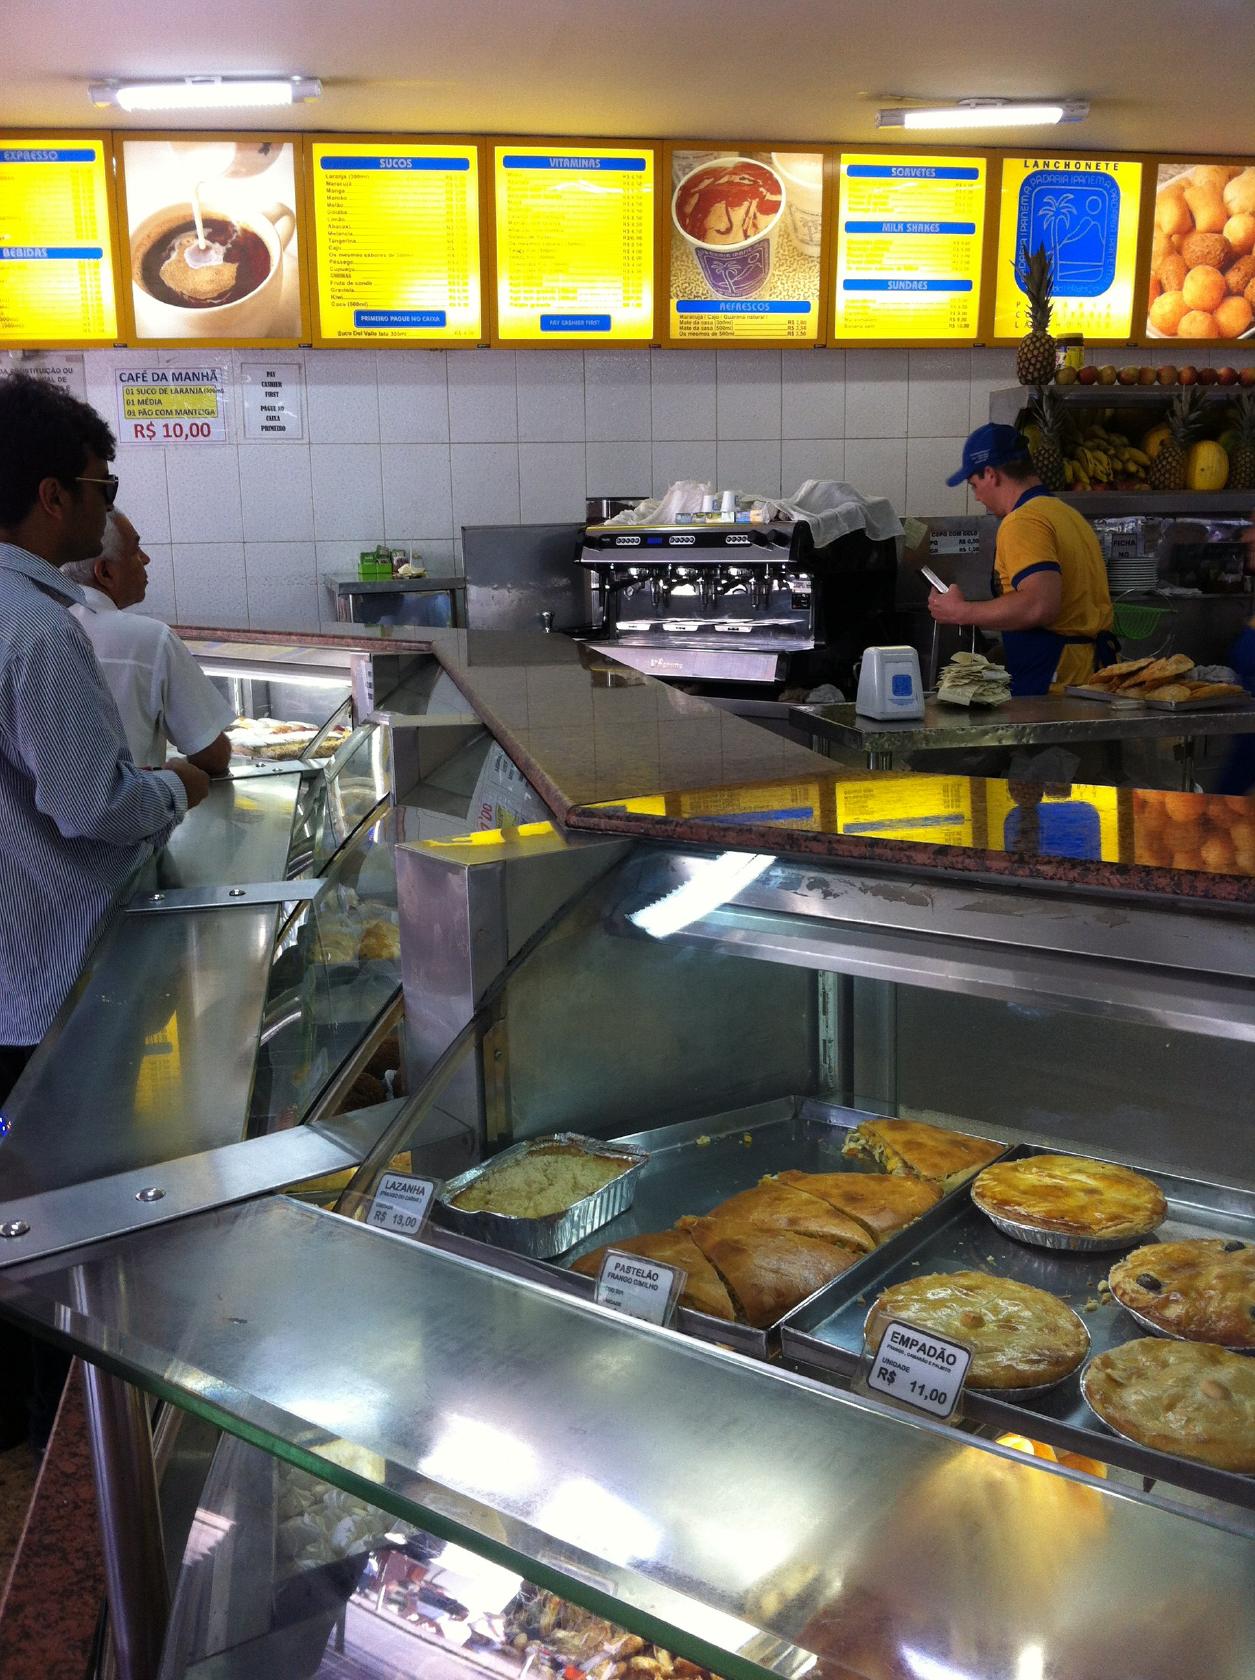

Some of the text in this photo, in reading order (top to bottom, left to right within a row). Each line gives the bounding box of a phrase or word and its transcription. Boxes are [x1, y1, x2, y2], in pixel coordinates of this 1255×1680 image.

[4, 150, 58, 161] EXPRESSO
[379, 158, 413, 168] SUCOS
[549, 157, 601, 168] VITAMINAS
[1023, 160, 1119, 171] LANCHONETE
[891, 167, 936, 177] SORVETES
[882, 223, 940, 233] MILK SHAKES
[3, 247, 49, 258] BEBIDAS
[888, 281, 928, 290] SUNDAES
[719, 302, 770, 312] REFRESCOS
[360, 314, 441, 323] PRIMEIRO PAGUE NO CAIXA
[119, 369, 218, 383] CAFÉ DA MANHÃ
[137, 397, 163, 406] MÉDIA
[138, 408, 153, 416] PÃO
[133, 421, 211, 441] R$ 10,00
[1113, 539, 1136, 547] FICHA
[385, 1180, 426, 1197] LAZANHA
[374, 1210, 417, 1228] R$ 13,00
[607, 1271, 632, 1284] FRANGO
[614, 1262, 659, 1282] PASTELÃO
[890, 1331, 957, 1366] EMPADÃO
[881, 1356, 912, 1374] UNIDADE
[876, 1366, 948, 1406] R$ 11,00
